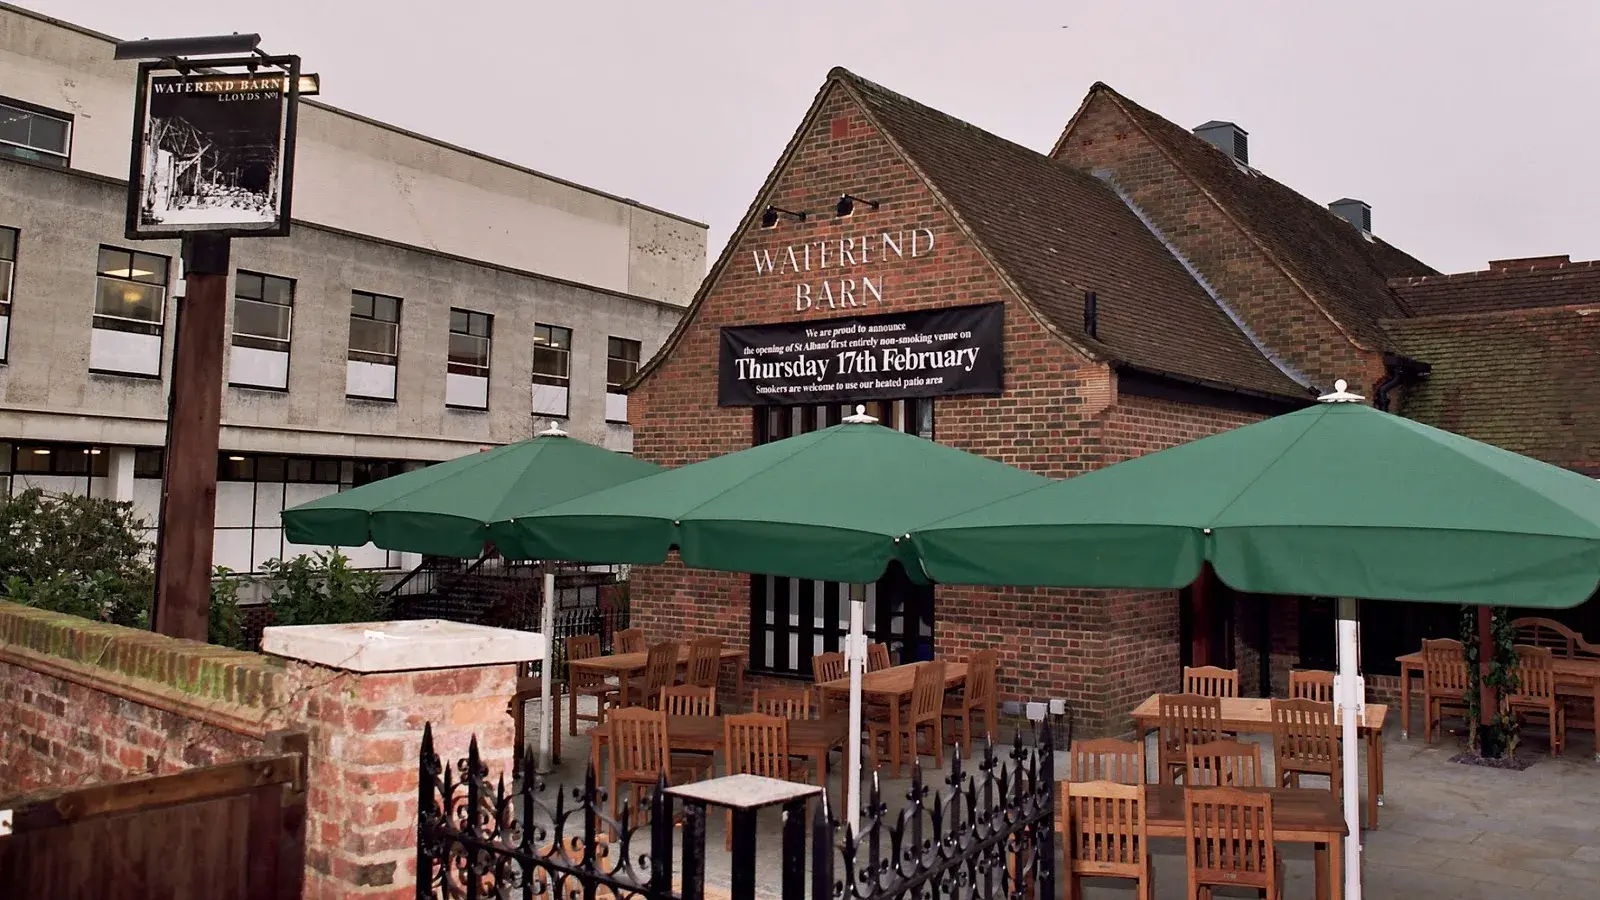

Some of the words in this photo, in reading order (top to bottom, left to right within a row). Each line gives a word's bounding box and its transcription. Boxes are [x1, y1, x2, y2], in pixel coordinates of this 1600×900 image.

[154, 79, 234, 94] WATEREND
[241, 78, 281, 90] BARN
[218, 92, 260, 102] LLOYDS
[753, 228, 935, 276] WATEREND
[796, 275, 885, 312] BARN
[805, 328, 818, 338] We
[819, 329, 831, 337] are
[832, 324, 856, 338] proud
[857, 324, 866, 333] to
[868, 323, 906, 333] announce
[744, 346, 754, 355] the
[755, 344, 784, 356] opening
[785, 343, 794, 353] of
[794, 342, 803, 352] St
[831, 339, 847, 349] first
[848, 337, 879, 348] entirely
[879, 333, 933, 345] non-smoking
[934, 331, 958, 341] venue
[959, 330, 972, 339] on
[735, 354, 830, 382] Thursday
[836, 350, 877, 375] 17th
[881, 347, 980, 372] February
[755, 384, 787, 394] Smokers
[788, 385, 801, 393] are
[803, 382, 835, 392] welcome
[836, 382, 844, 391] to
[845, 381, 858, 390] use
[859, 381, 874, 389] our
[875, 377, 902, 389] heated
[903, 376, 924, 389] patio
[925, 376, 943, 385] area
